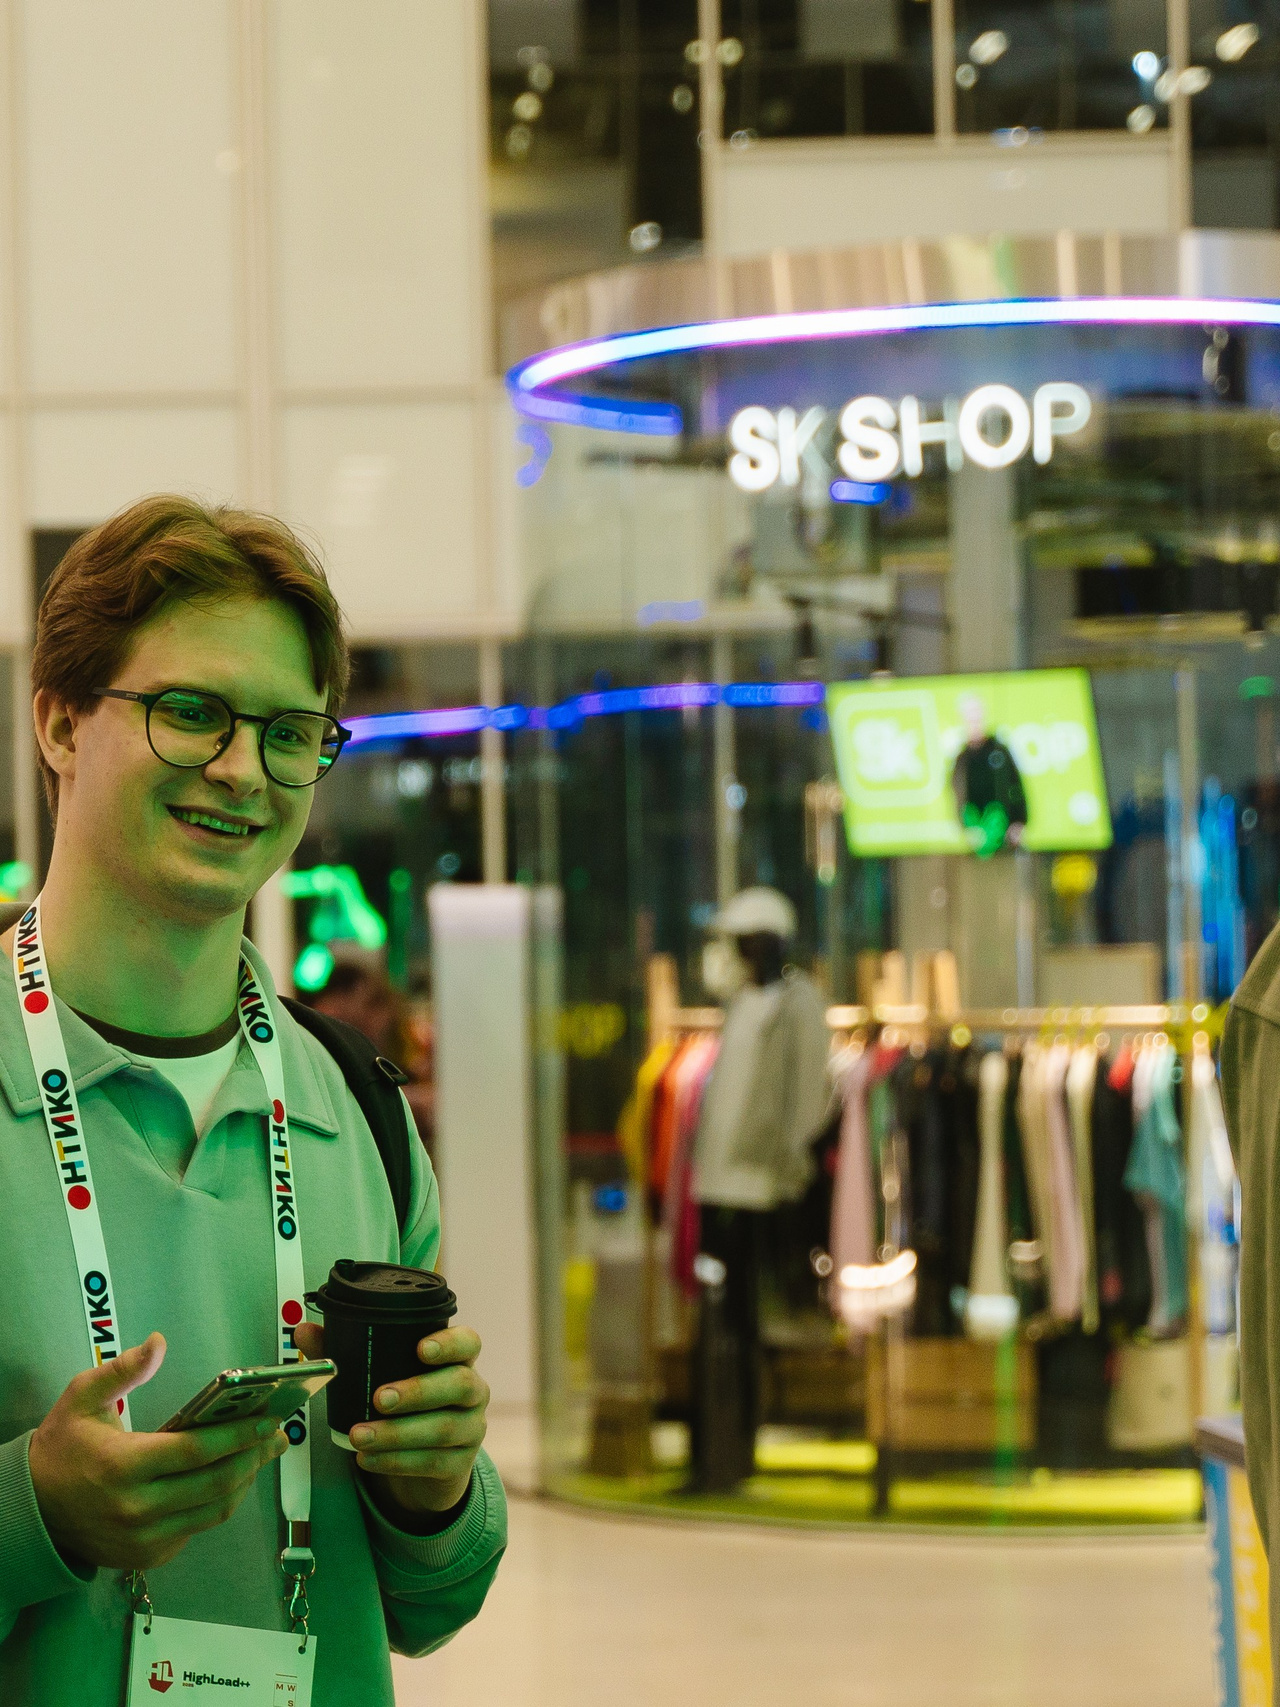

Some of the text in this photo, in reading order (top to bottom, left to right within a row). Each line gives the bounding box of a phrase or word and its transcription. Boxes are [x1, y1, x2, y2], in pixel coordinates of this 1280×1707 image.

[729, 382, 1092, 492] SK SHOP
[183, 1671, 251, 1688] HighLoad++
